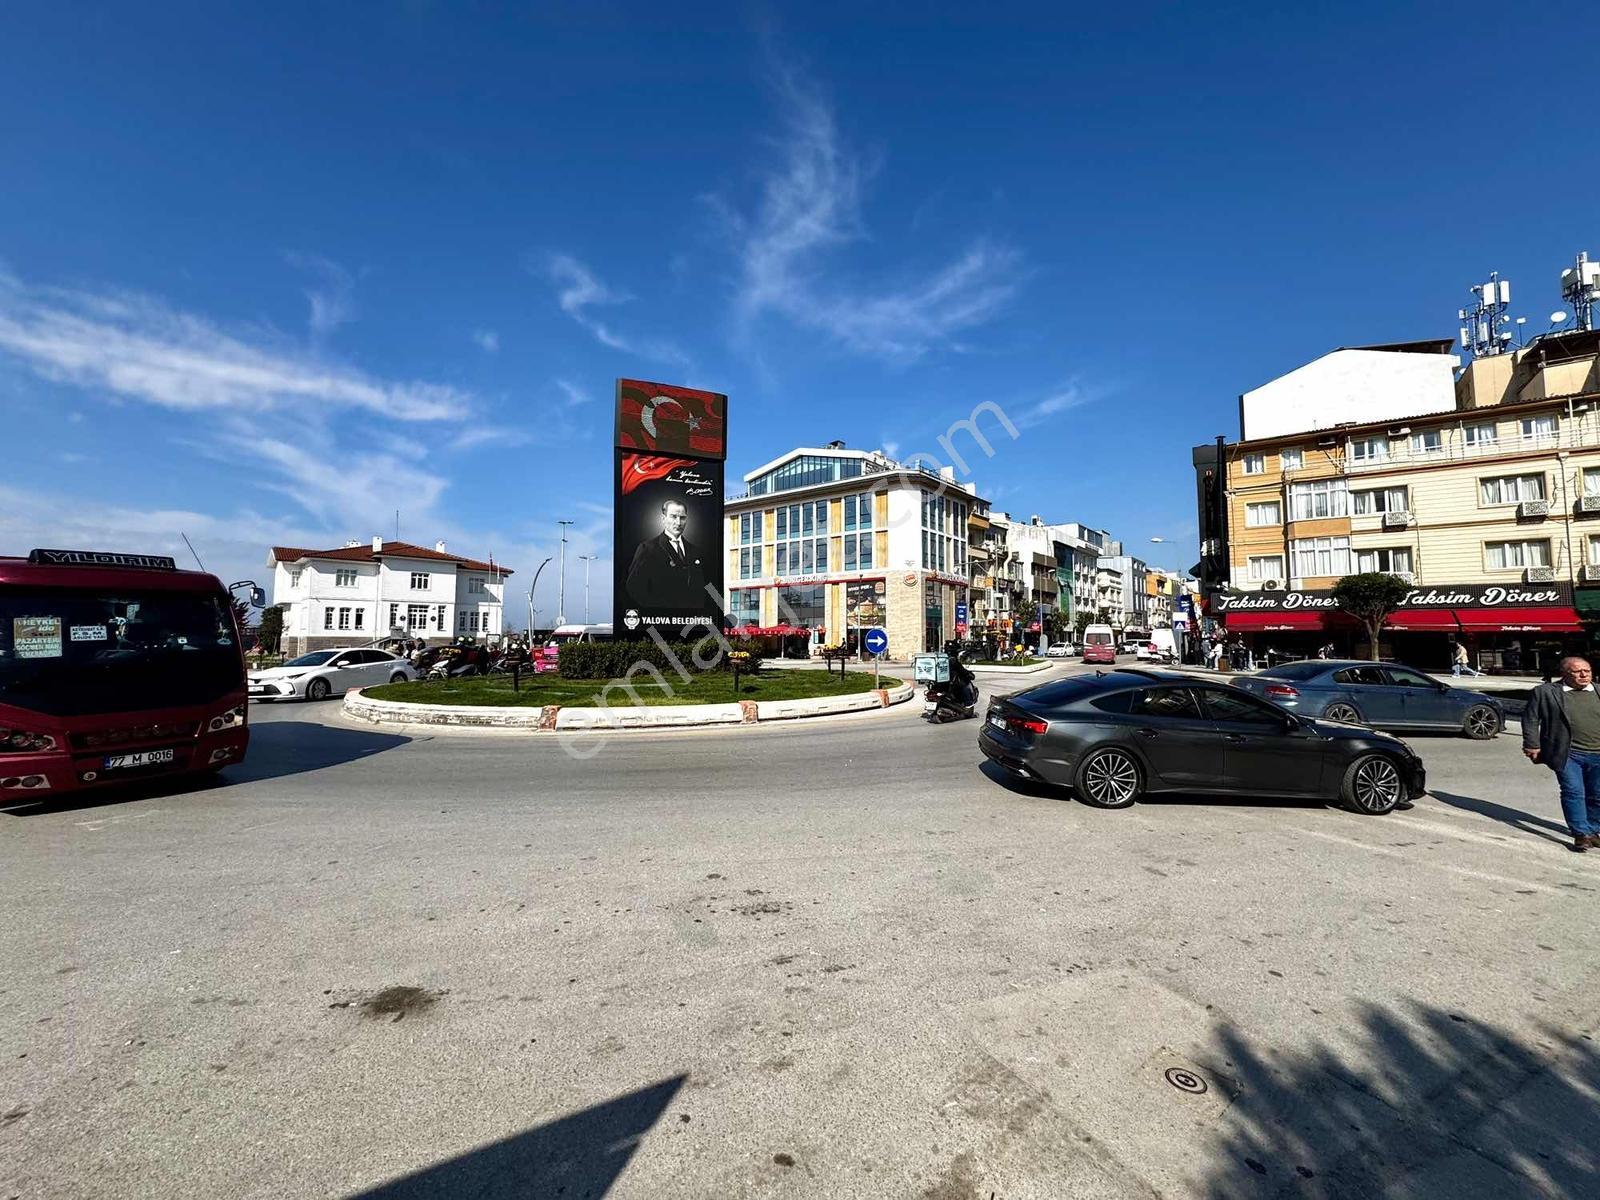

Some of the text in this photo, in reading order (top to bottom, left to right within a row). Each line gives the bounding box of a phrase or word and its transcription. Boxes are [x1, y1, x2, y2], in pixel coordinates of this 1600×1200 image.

[43, 551, 168, 569] YILDIRIM
[1218, 592, 1340, 610] Taksim Döner
[1397, 587, 1560, 606] Taksim Döner
[641, 615, 713, 625] YALOVA BELEDİYESİ
[111, 750, 172, 766] 77 M 0016
